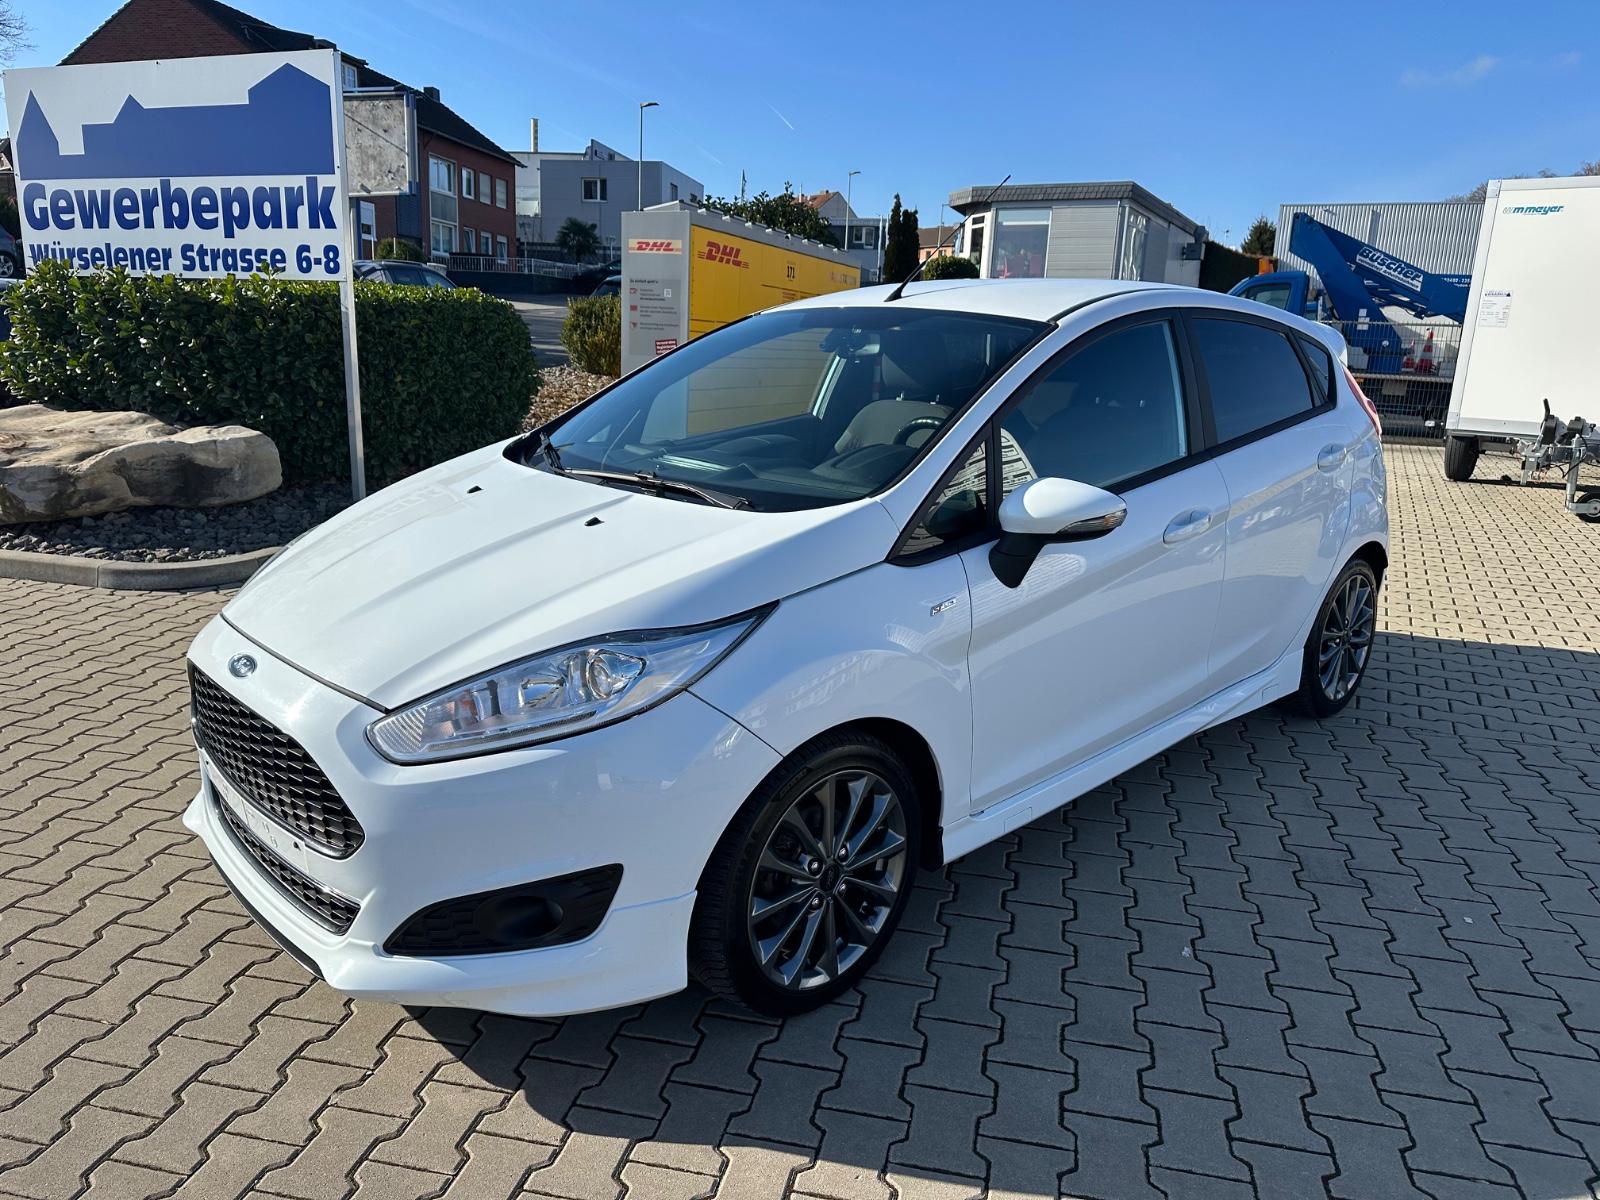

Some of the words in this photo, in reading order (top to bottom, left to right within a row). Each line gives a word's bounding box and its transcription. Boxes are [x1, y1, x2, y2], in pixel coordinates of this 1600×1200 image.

[22, 176, 337, 239] Gewerbepark
[29, 241, 172, 271] Würselener
[181, 244, 286, 273] Strasse
[296, 244, 340, 275] 6-8
[636, 241, 674, 252] DHL
[706, 240, 742, 267] DHL
[786, 265, 796, 279] 171
[1359, 248, 1423, 281] Büscher
